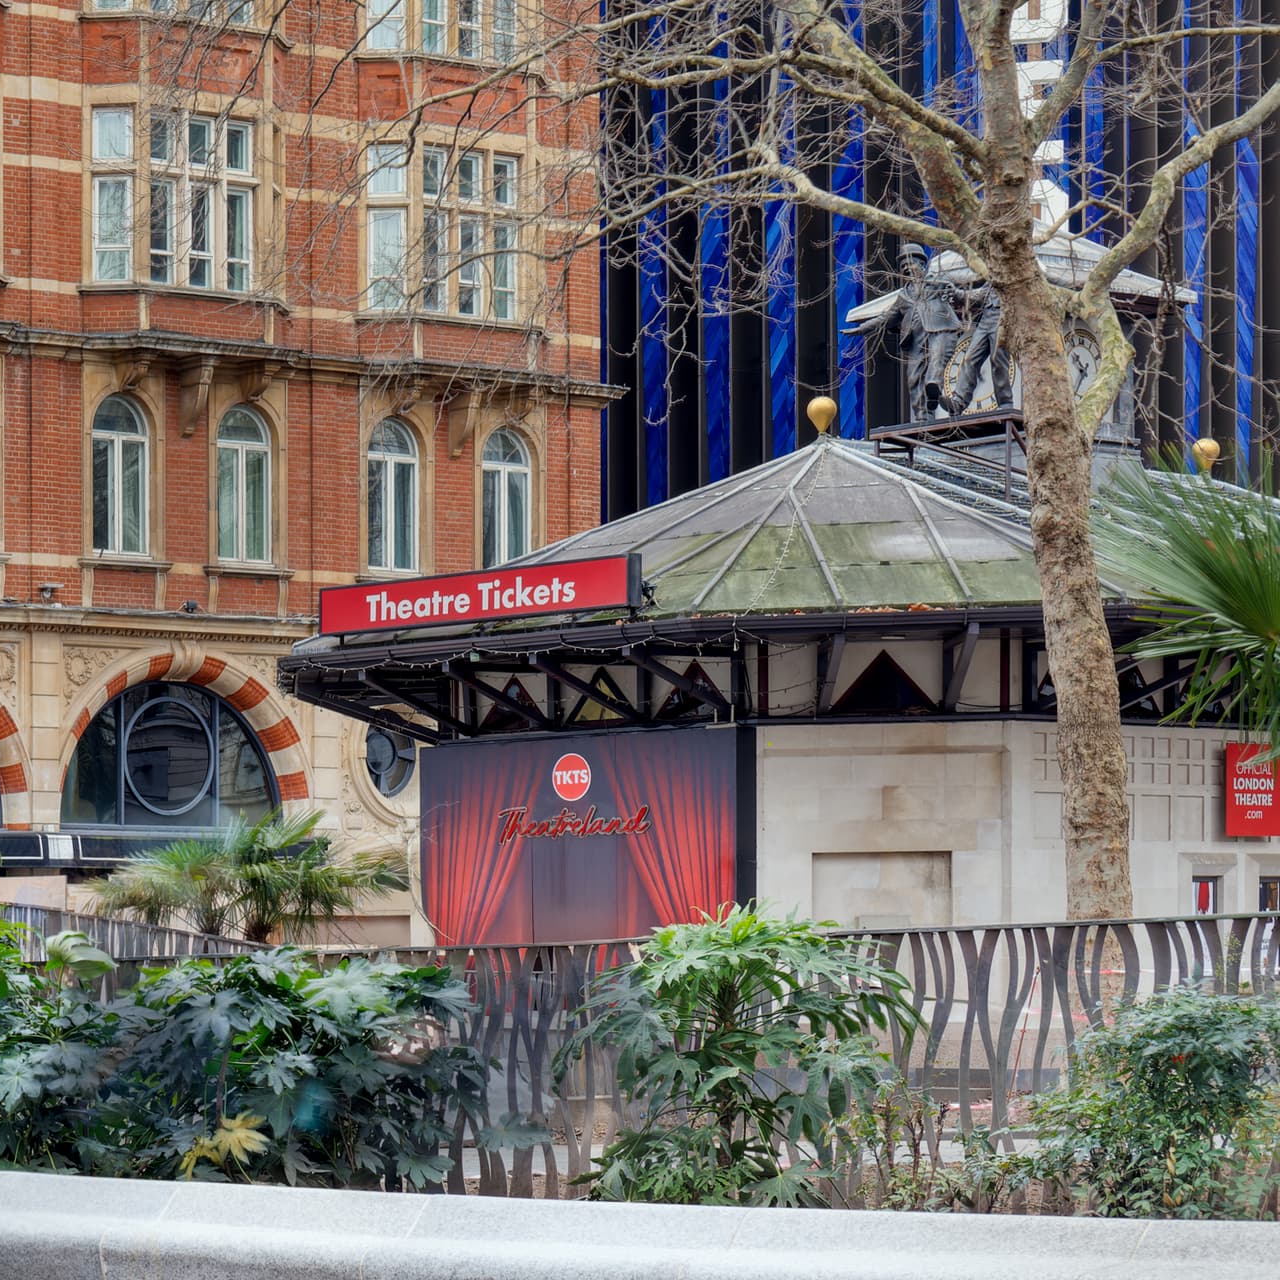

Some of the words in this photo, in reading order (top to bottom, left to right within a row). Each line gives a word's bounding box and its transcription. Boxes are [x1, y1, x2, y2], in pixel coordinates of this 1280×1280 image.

[366, 590, 471, 622] Theatre
[477, 576, 576, 611] Tickets
[555, 769, 589, 785] TKTS
[1233, 778, 1274, 790] LONDON
[1235, 793, 1272, 806] THEATRE
[1245, 810, 1263, 819] .com
[498, 804, 651, 845] Theatreland
